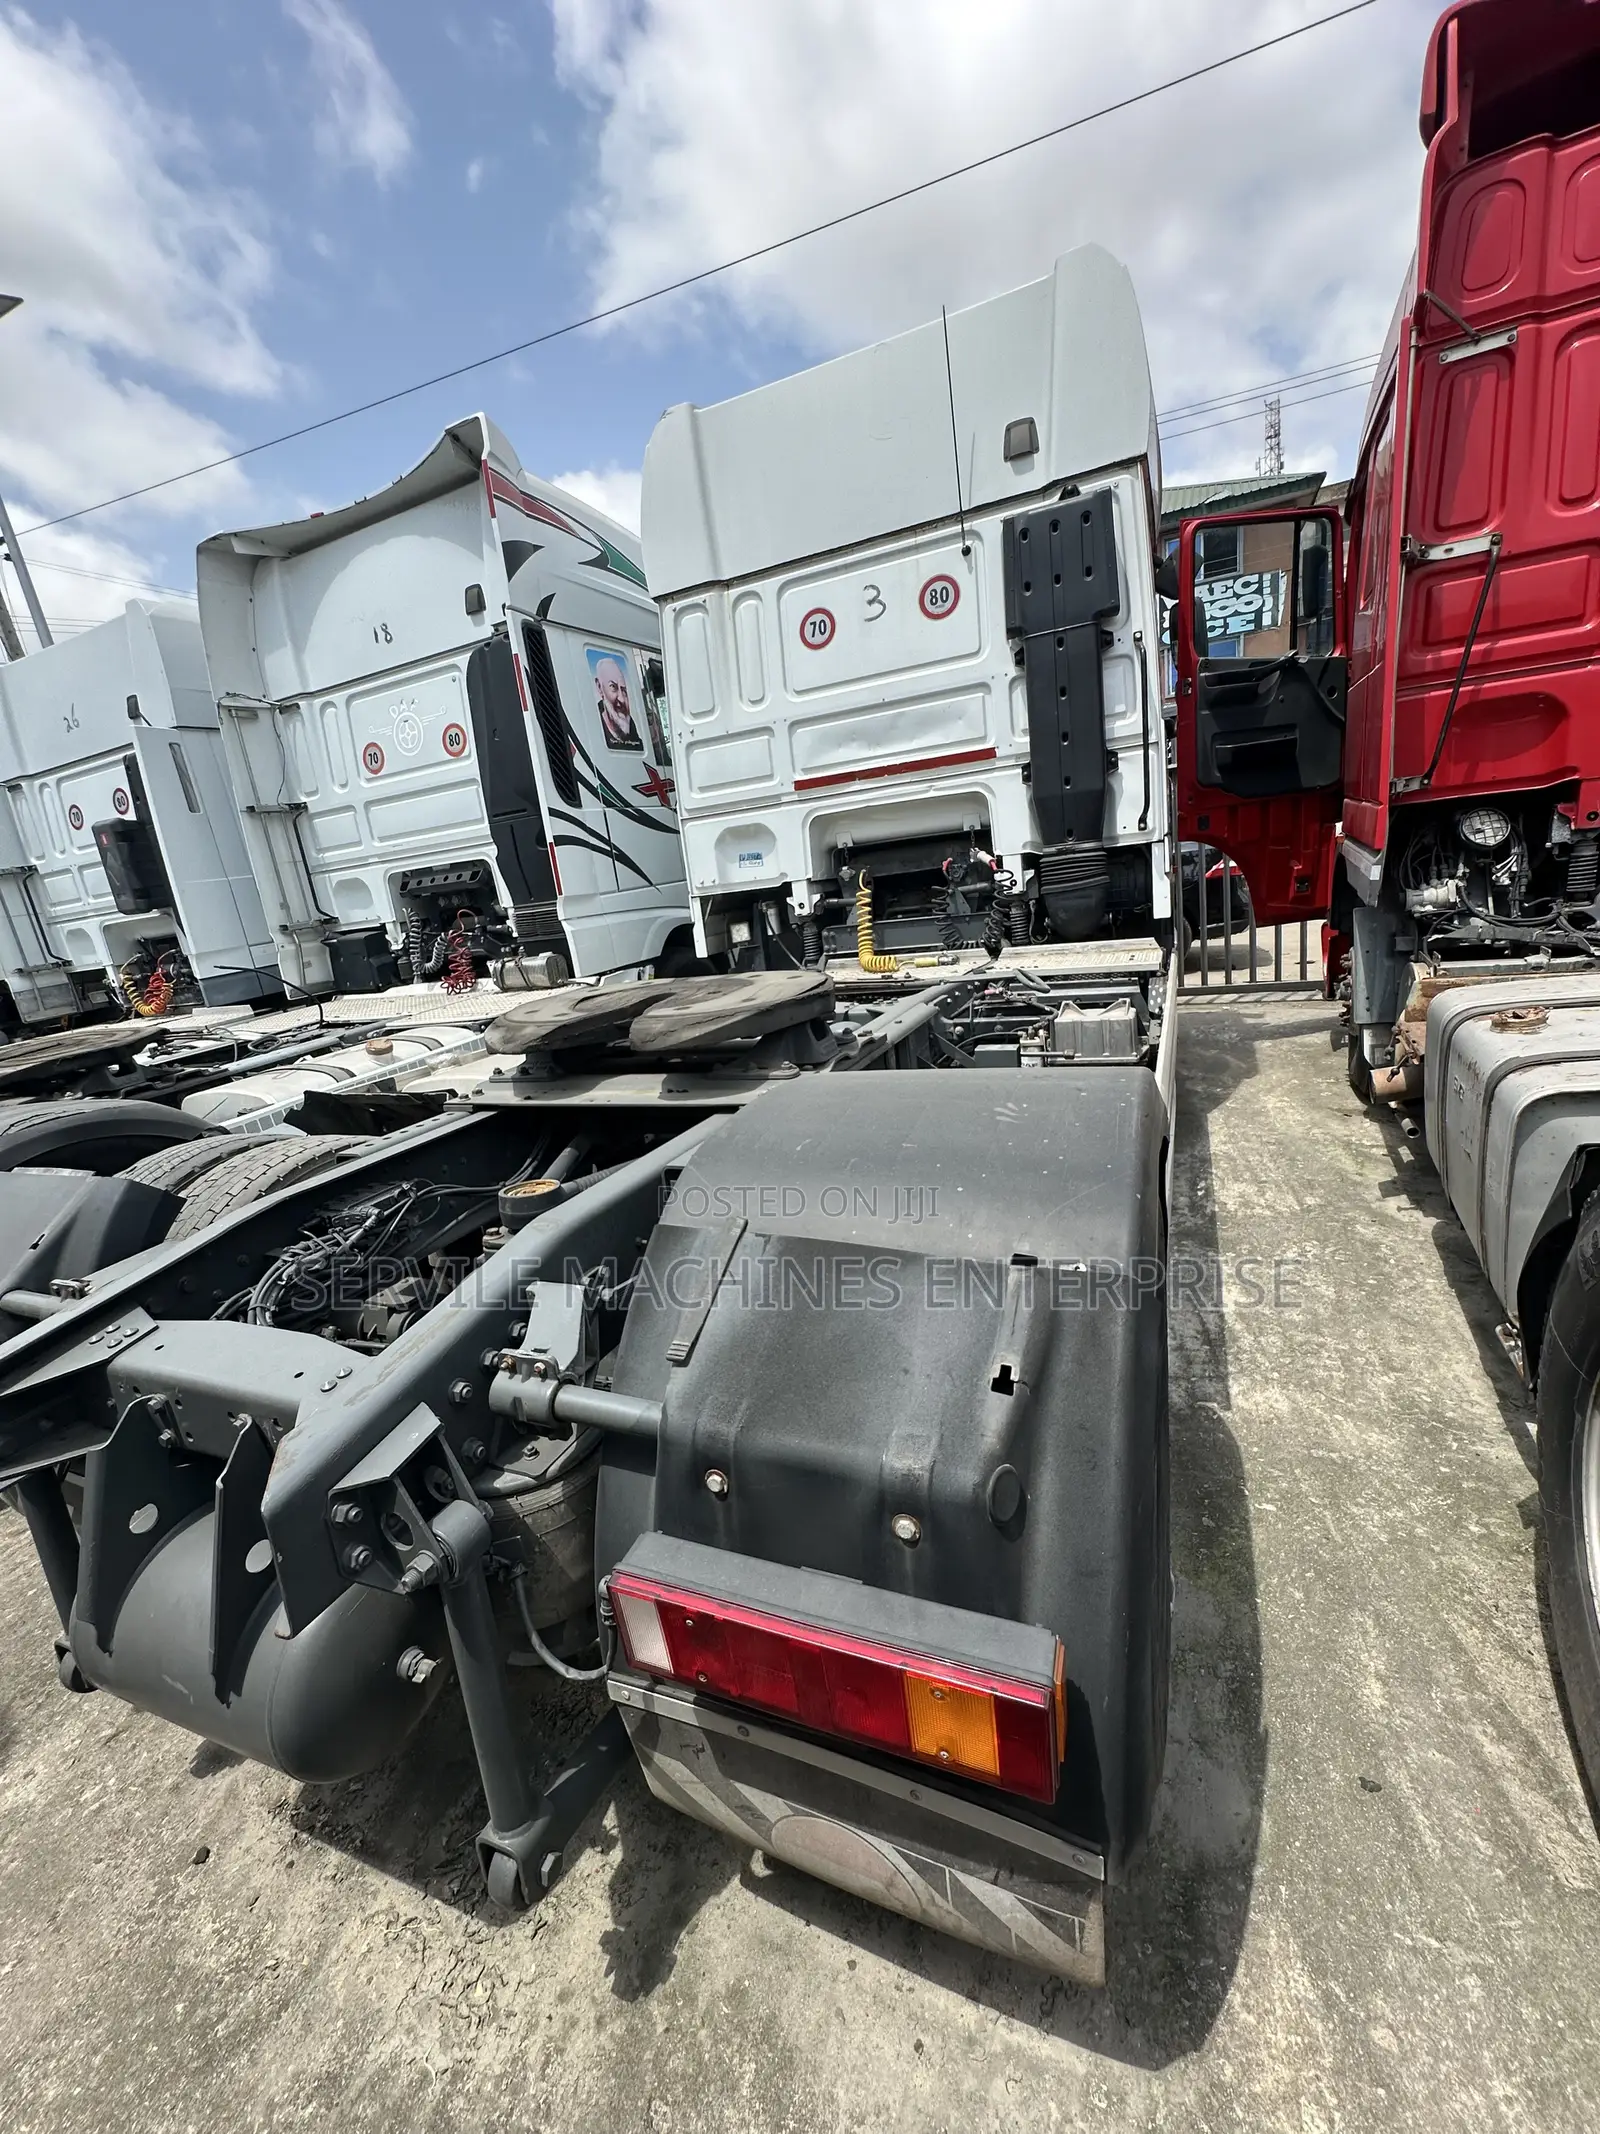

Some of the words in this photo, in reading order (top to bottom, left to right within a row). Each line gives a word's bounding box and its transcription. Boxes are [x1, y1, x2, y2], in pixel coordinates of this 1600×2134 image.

[863, 584, 887, 622] 3
[929, 586, 950, 606] 80
[373, 622, 394, 644] 18
[809, 619, 828, 638] 70
[63, 702, 80, 733] 26
[448, 732, 461, 748] 80
[367, 752, 379, 766] 70
[116, 795, 126, 808] 80
[72, 812, 81, 823] 70
